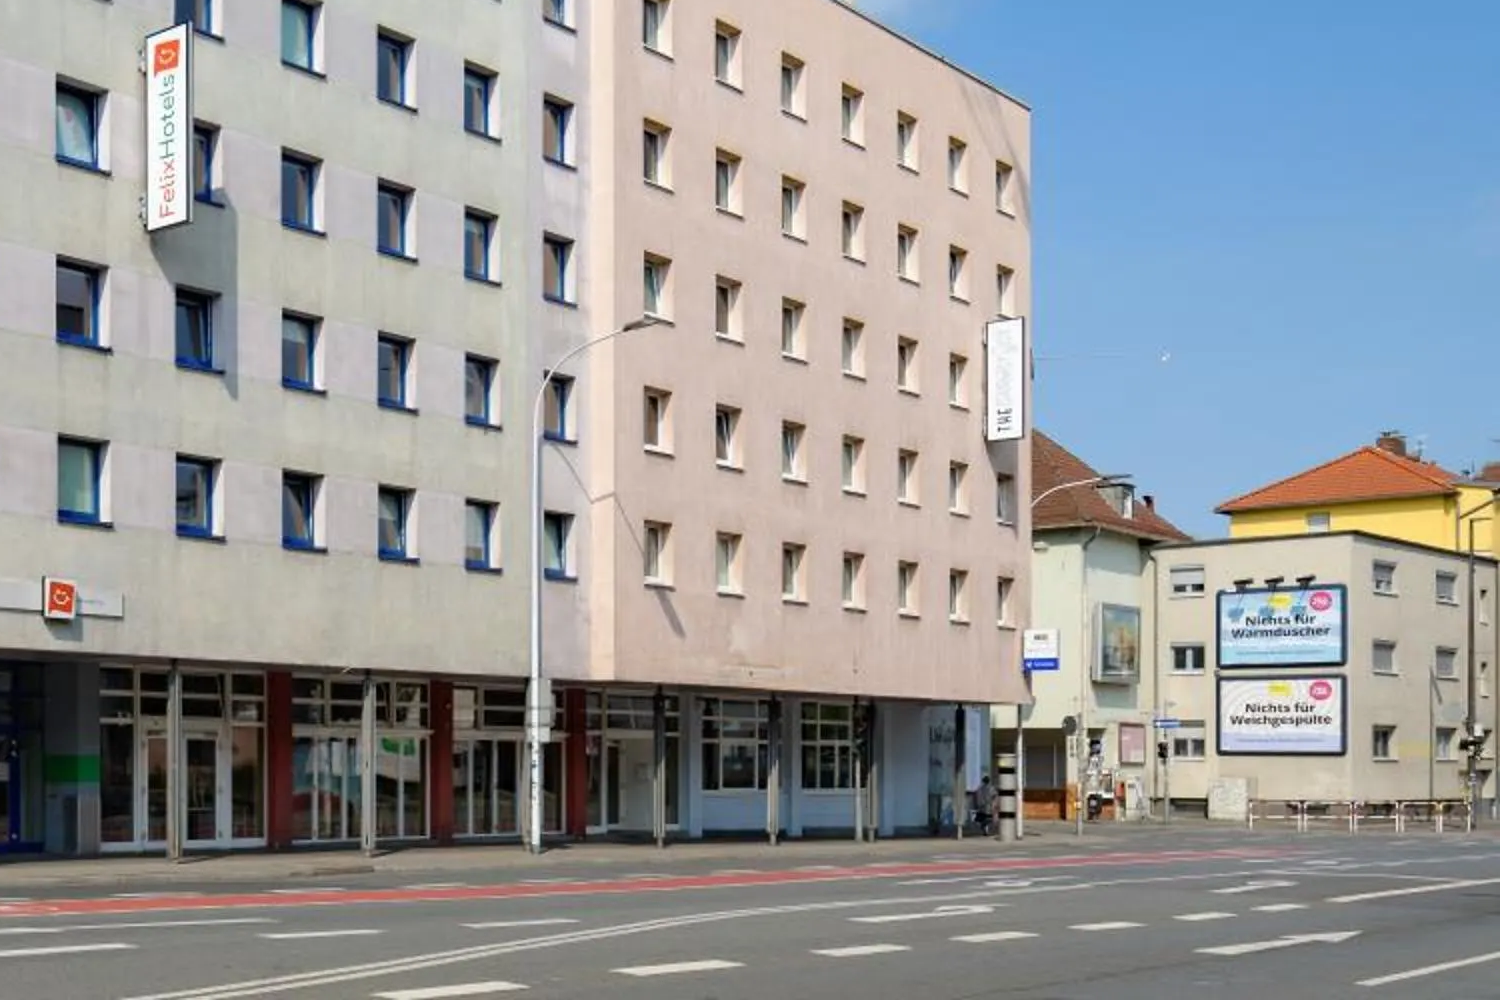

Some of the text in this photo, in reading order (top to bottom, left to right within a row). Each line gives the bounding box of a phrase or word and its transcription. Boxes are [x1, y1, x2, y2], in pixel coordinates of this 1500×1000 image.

[158, 74, 176, 220] FelixHotels
[1245, 614, 1316, 626] Nichts für
[1231, 625, 1331, 639] Warmduscher
[1245, 702, 1316, 713] Nichts für
